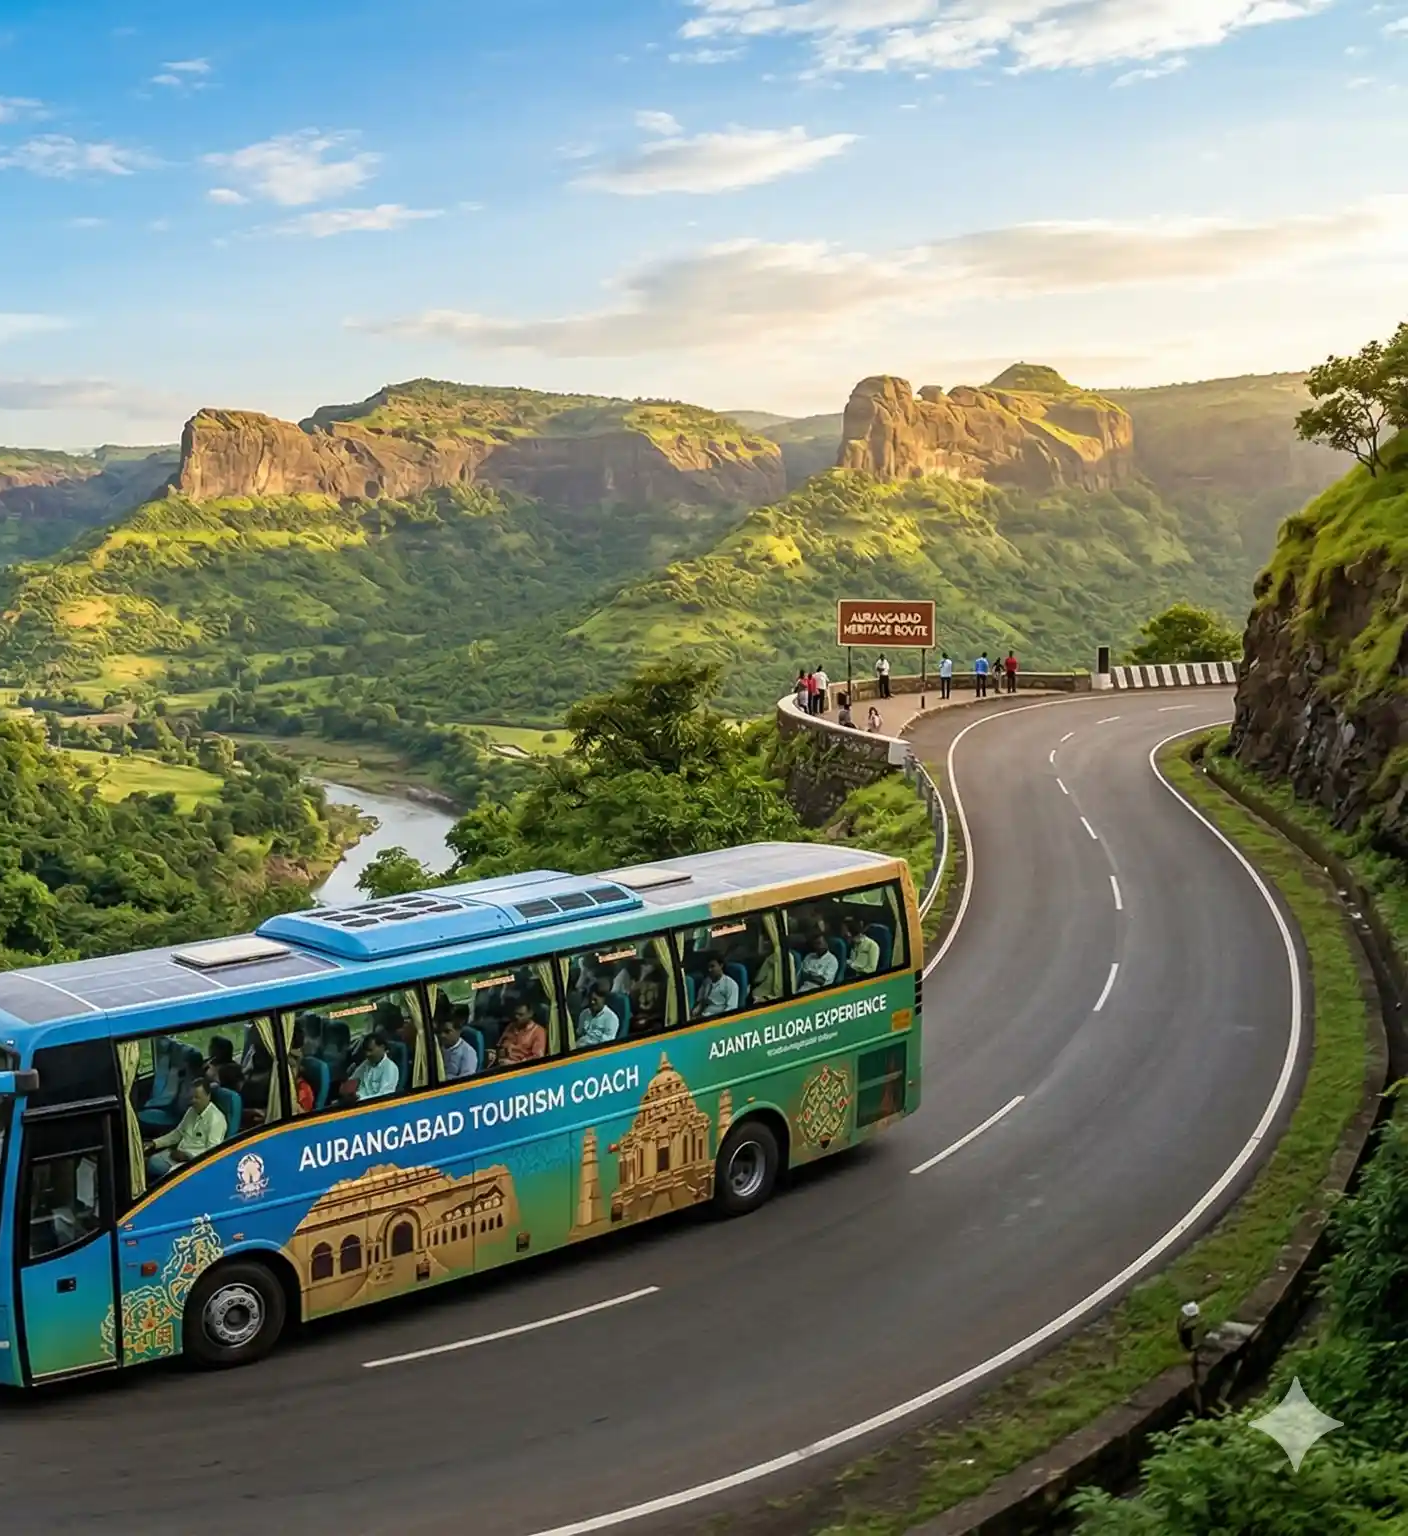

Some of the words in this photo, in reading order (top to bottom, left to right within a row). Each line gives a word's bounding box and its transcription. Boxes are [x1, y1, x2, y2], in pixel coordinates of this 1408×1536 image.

[709, 1030, 762, 1060] AJANTA
[764, 1015, 813, 1044] ELLORA
[815, 994, 887, 1030] EXPERIENCE
[298, 1110, 464, 1172] AURANGABAD
[469, 1085, 565, 1129] TOURISM
[570, 1064, 639, 1104] COACH
